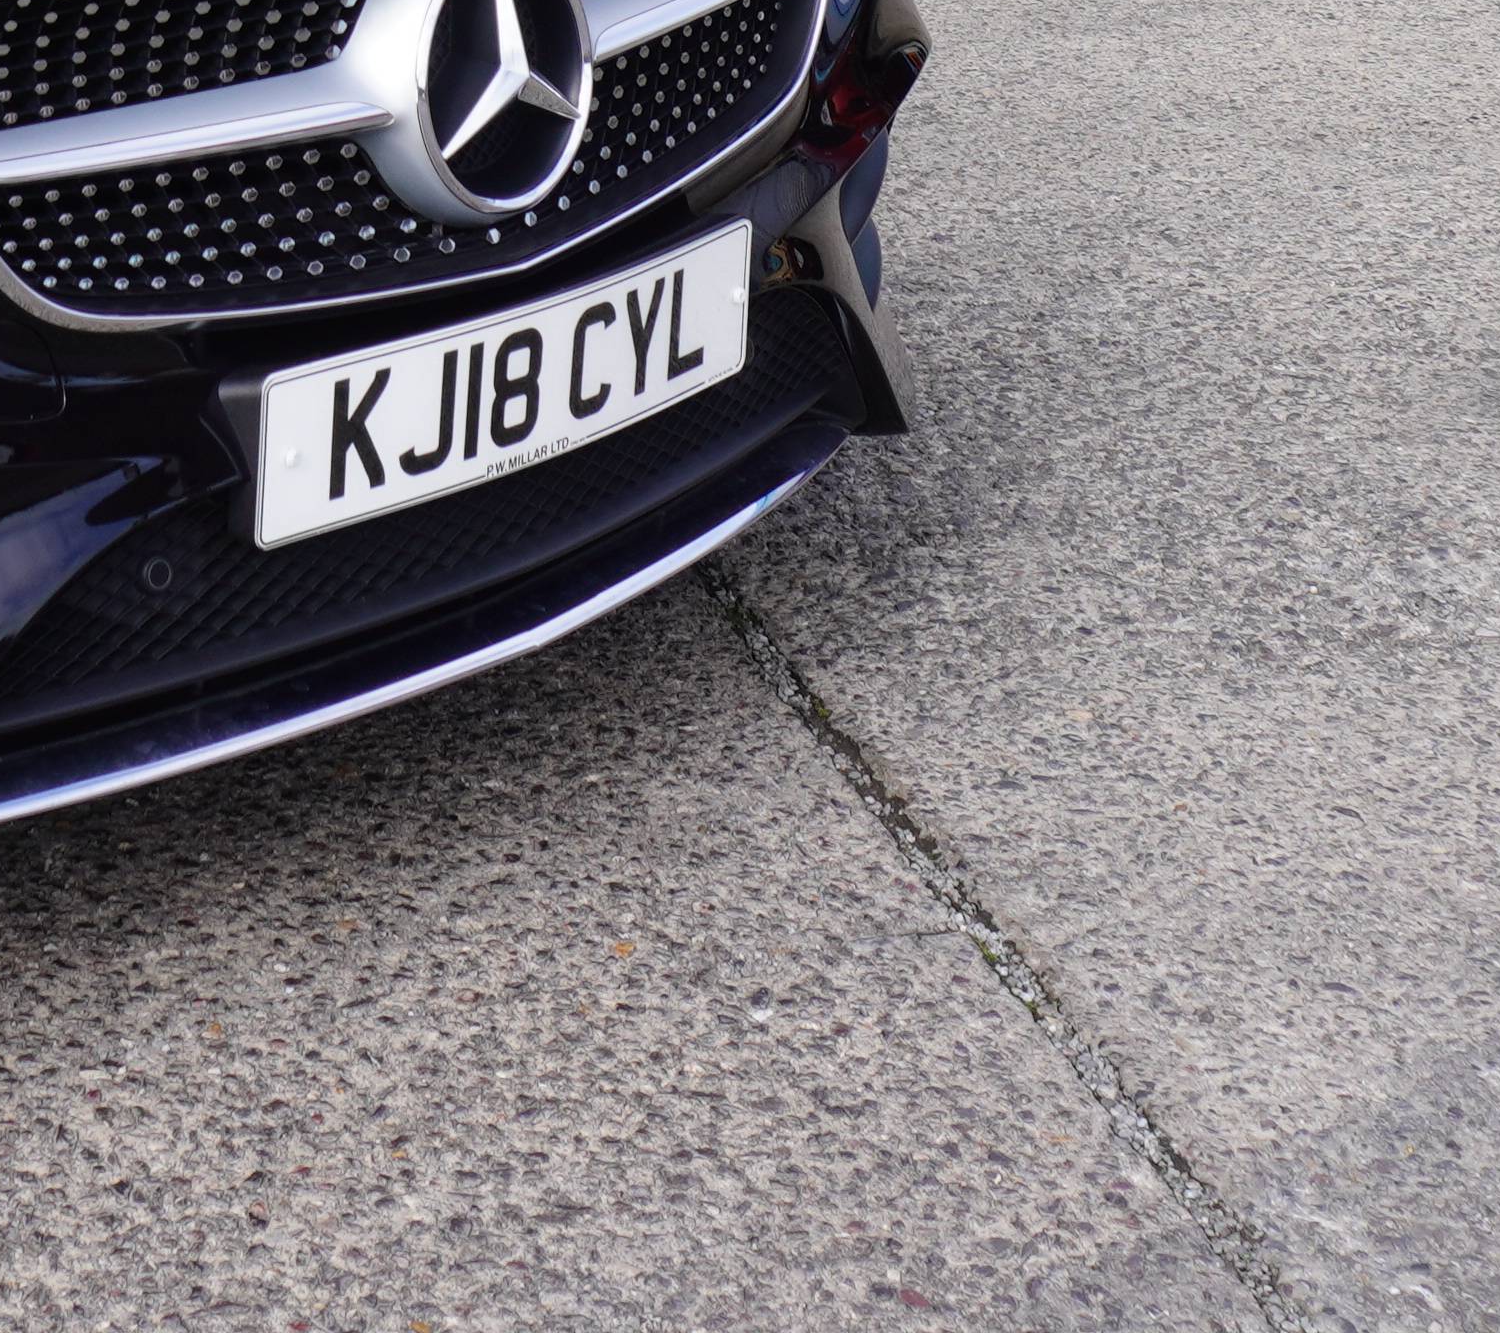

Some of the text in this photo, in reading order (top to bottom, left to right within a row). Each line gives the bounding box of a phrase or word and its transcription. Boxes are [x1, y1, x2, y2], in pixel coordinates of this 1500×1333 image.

[328, 268, 705, 501] KJ18 CYL
[550, 436, 570, 454] LTD
